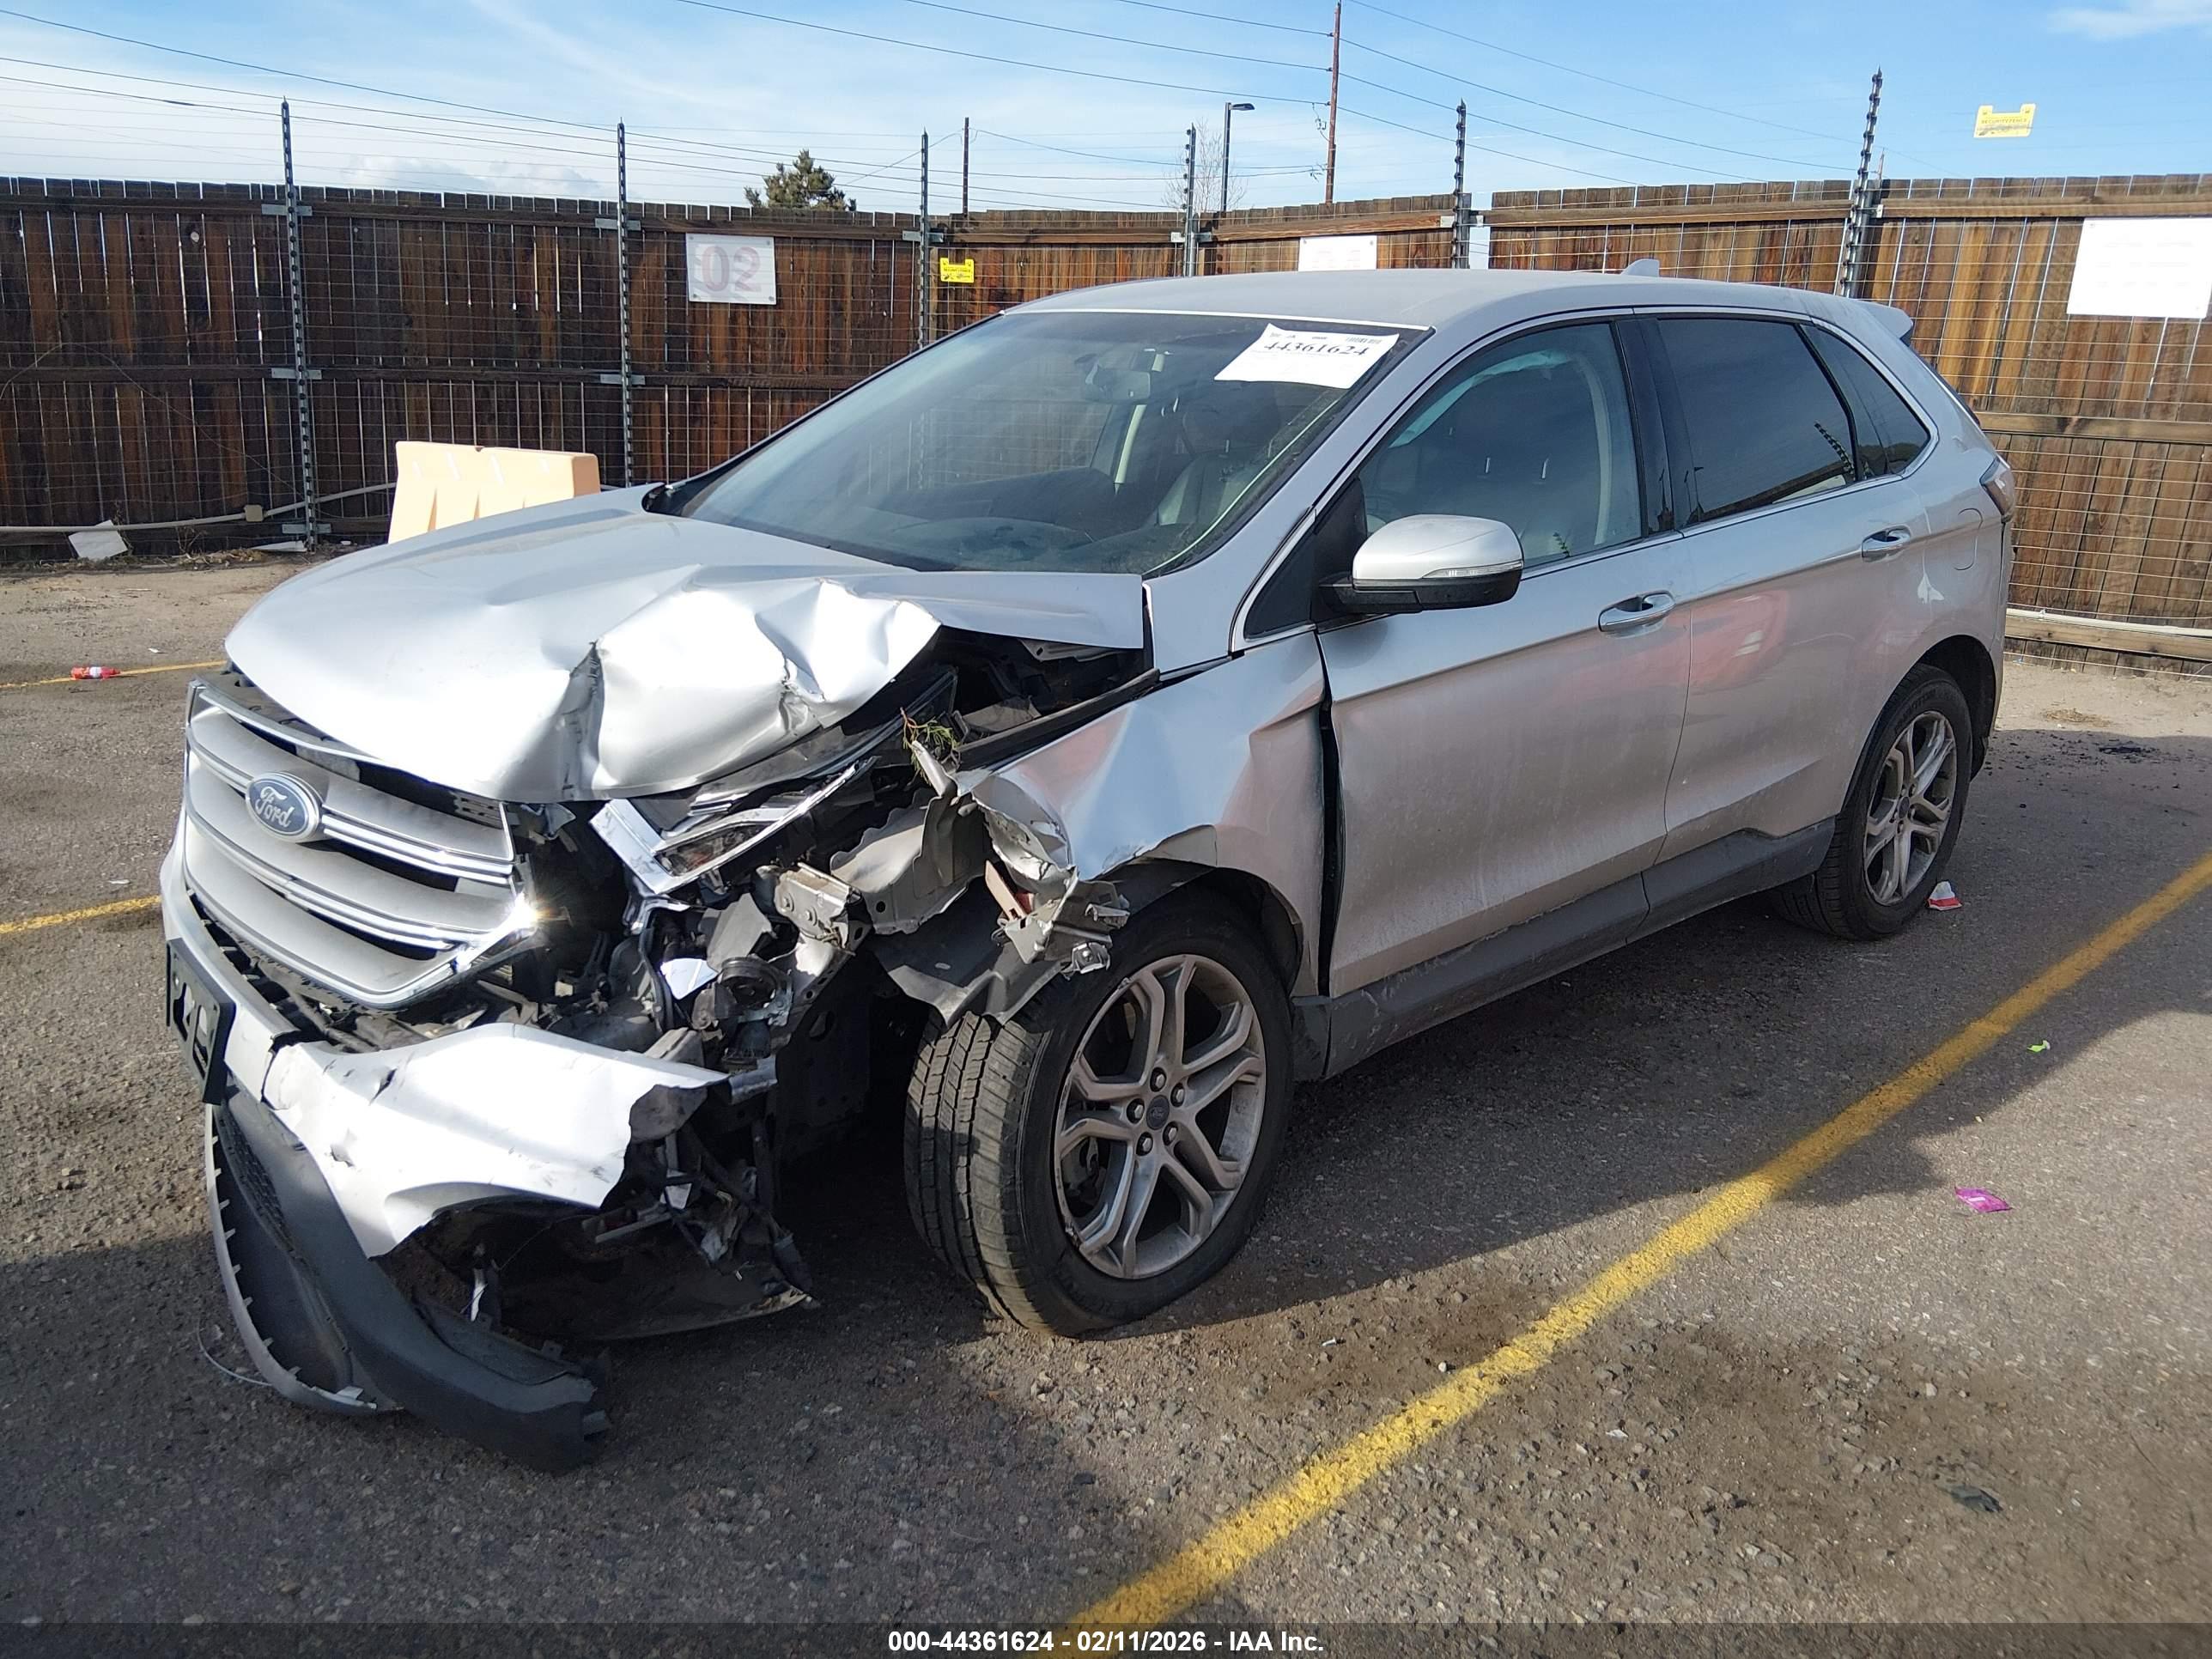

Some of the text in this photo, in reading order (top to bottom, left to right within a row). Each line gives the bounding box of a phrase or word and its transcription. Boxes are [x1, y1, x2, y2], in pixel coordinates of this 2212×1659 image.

[701, 246, 762, 292] 02
[1263, 341, 1370, 356] 44361624
[255, 786, 295, 828] Ford
